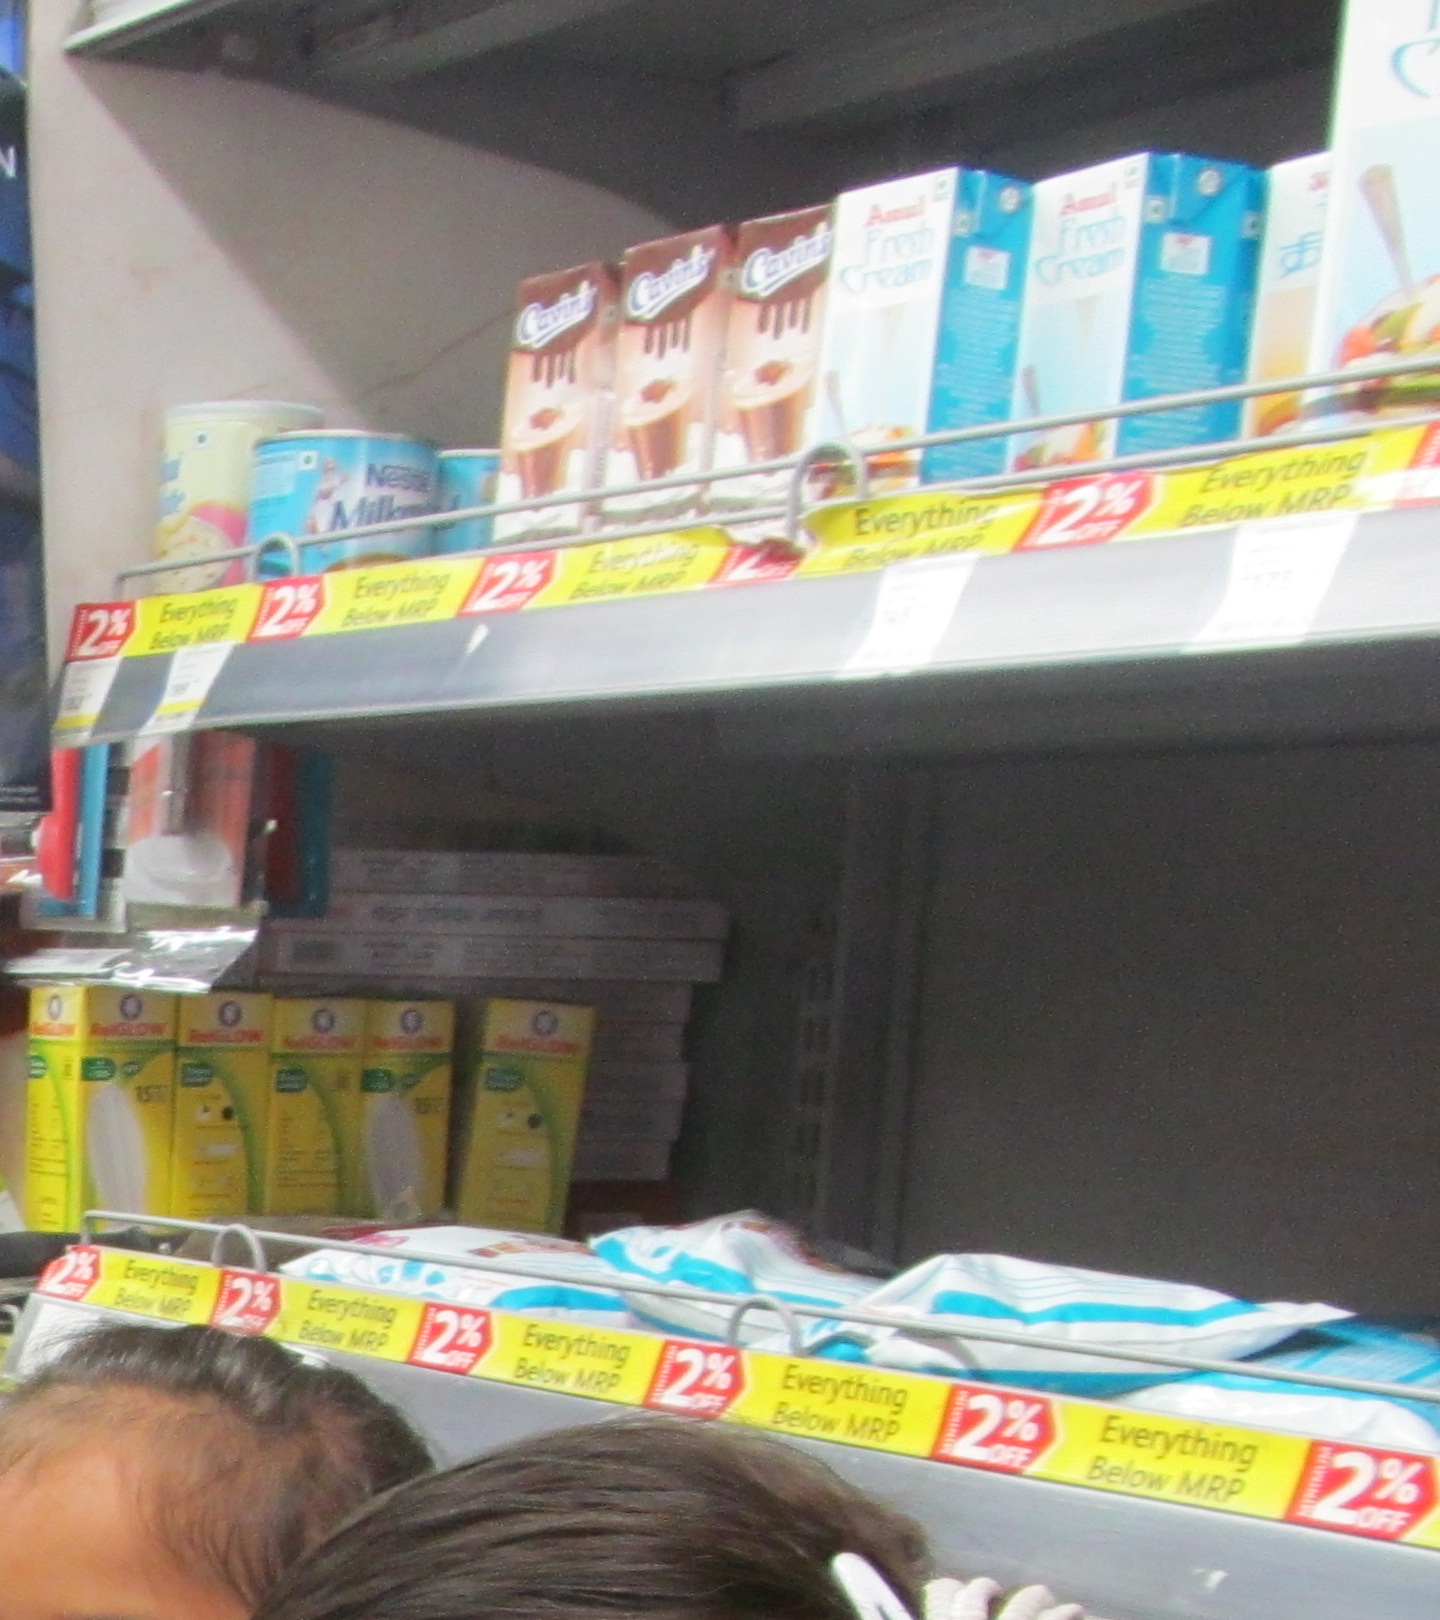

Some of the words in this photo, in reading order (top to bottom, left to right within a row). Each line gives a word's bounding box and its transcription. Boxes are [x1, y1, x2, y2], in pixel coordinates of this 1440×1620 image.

[1198, 449, 1370, 495] Everything
[853, 499, 1001, 538] Everything
[1031, 481, 1145, 547] 2%
[1179, 502, 1268, 528] Below
[1277, 483, 1356, 516] MRP
[469, 557, 553, 613] 2%
[77, 608, 131, 657] 2%
[158, 597, 240, 626] Everything
[259, 582, 322, 638] 2%
[42, 1251, 98, 1293] 2%
[126, 1259, 199, 1294] Everything
[218, 1276, 276, 1327] 2%
[307, 1289, 398, 1331] Everything
[298, 1319, 344, 1344] Below
[349, 1327, 391, 1351] MRP
[419, 1309, 487, 1363] 2%
[522, 1322, 633, 1371] Everything
[514, 1356, 570, 1386] Below
[570, 1367, 622, 1396] MRP
[657, 1347, 736, 1406] 2%
[780, 1363, 910, 1416] Everything
[770, 1400, 836, 1433] Below
[844, 1413, 902, 1444] MRP
[950, 1393, 1044, 1462] 2%
[1099, 1414, 1260, 1473] Everything
[988, 1443, 1034, 1468] OFF
[1085, 1454, 1168, 1493] Below
[1175, 1470, 1248, 1505] MRP
[1298, 1445, 1333, 1519] MINIMUM
[1312, 1450, 1426, 1526] 2%
[1355, 1505, 1413, 1534] OFF
